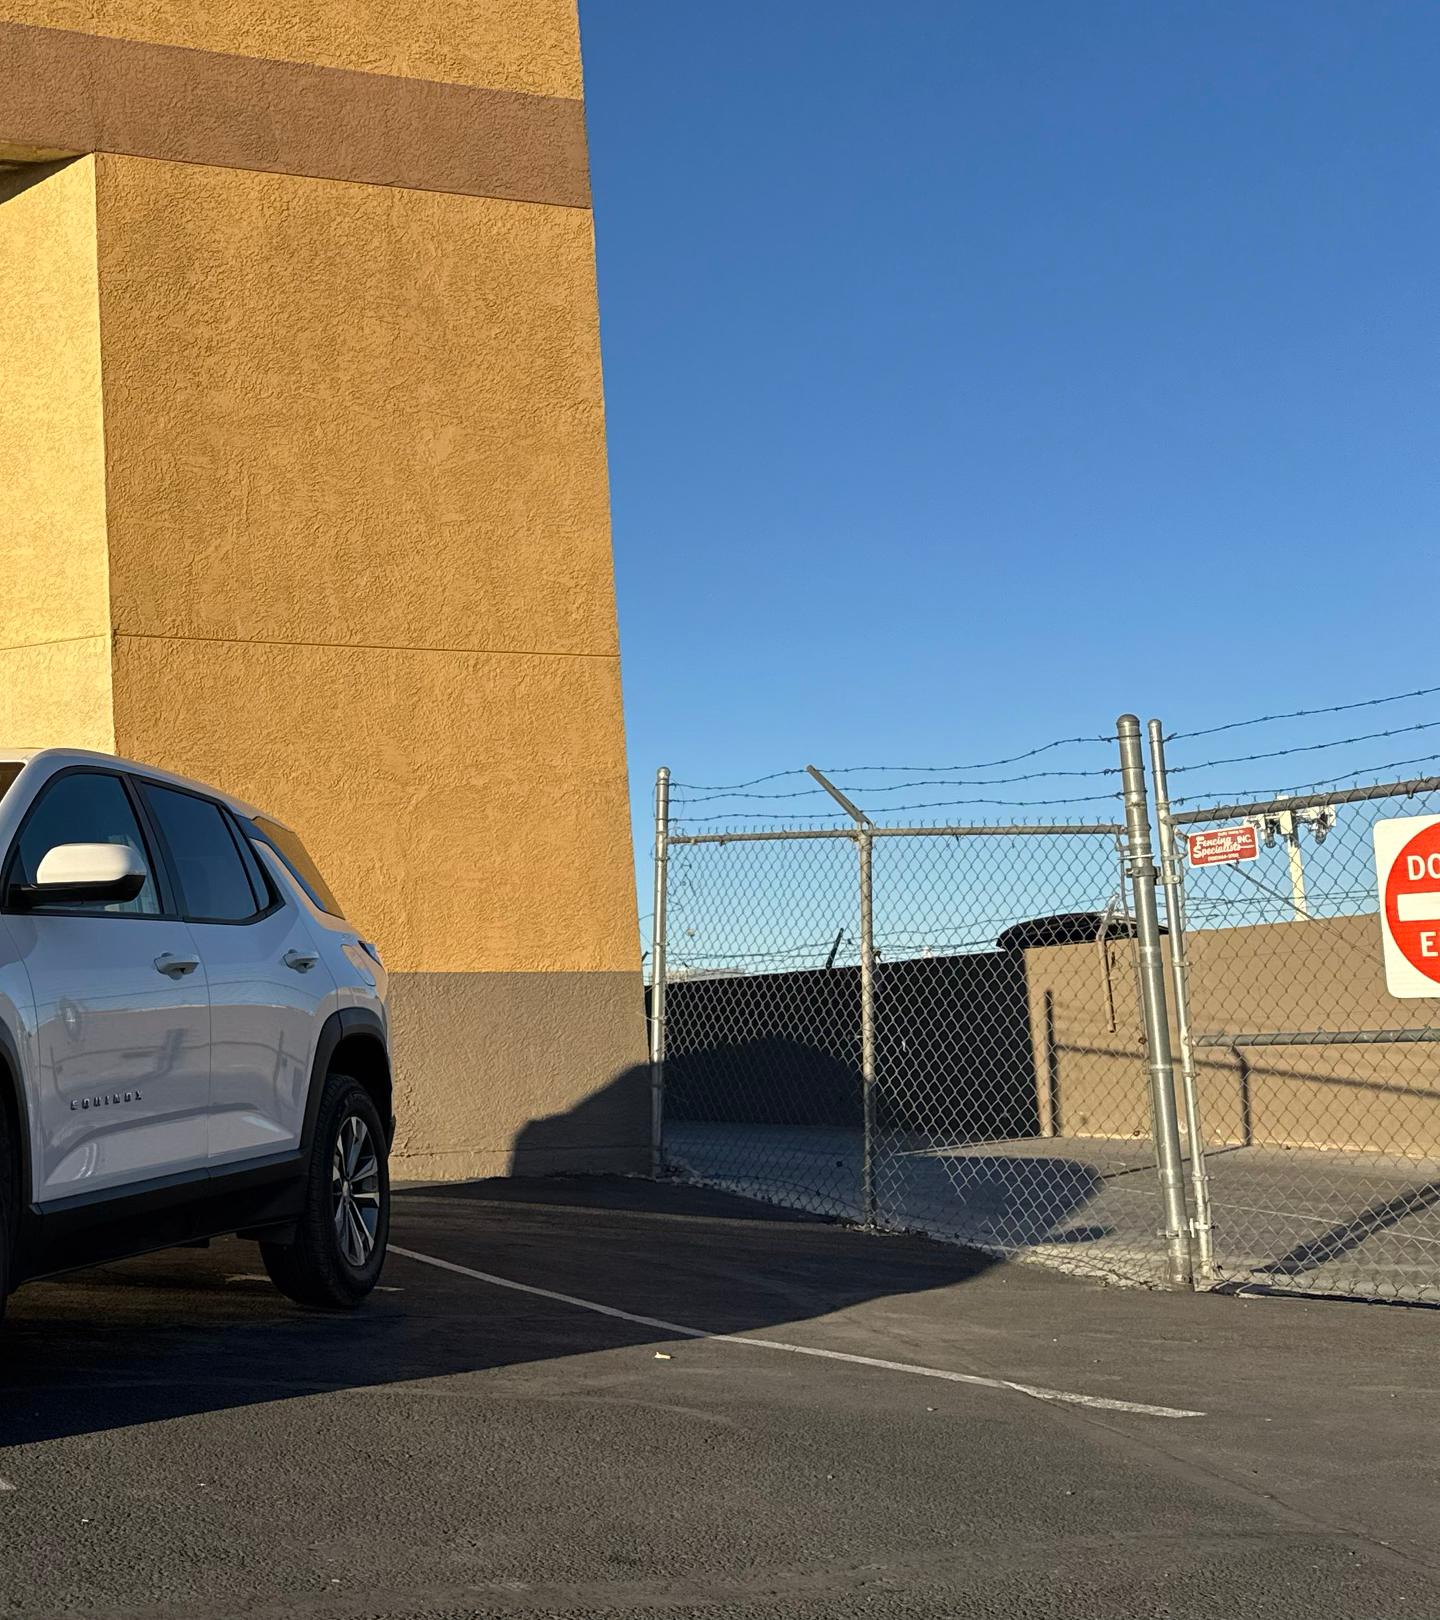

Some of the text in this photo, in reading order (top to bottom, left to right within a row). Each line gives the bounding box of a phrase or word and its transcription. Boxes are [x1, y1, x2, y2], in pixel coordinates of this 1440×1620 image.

[1192, 842, 1241, 858] Specialists
[1195, 835, 1232, 848] Fencing
[1407, 853, 1440, 881] DO
[70, 1089, 143, 1111] EQUINOX
